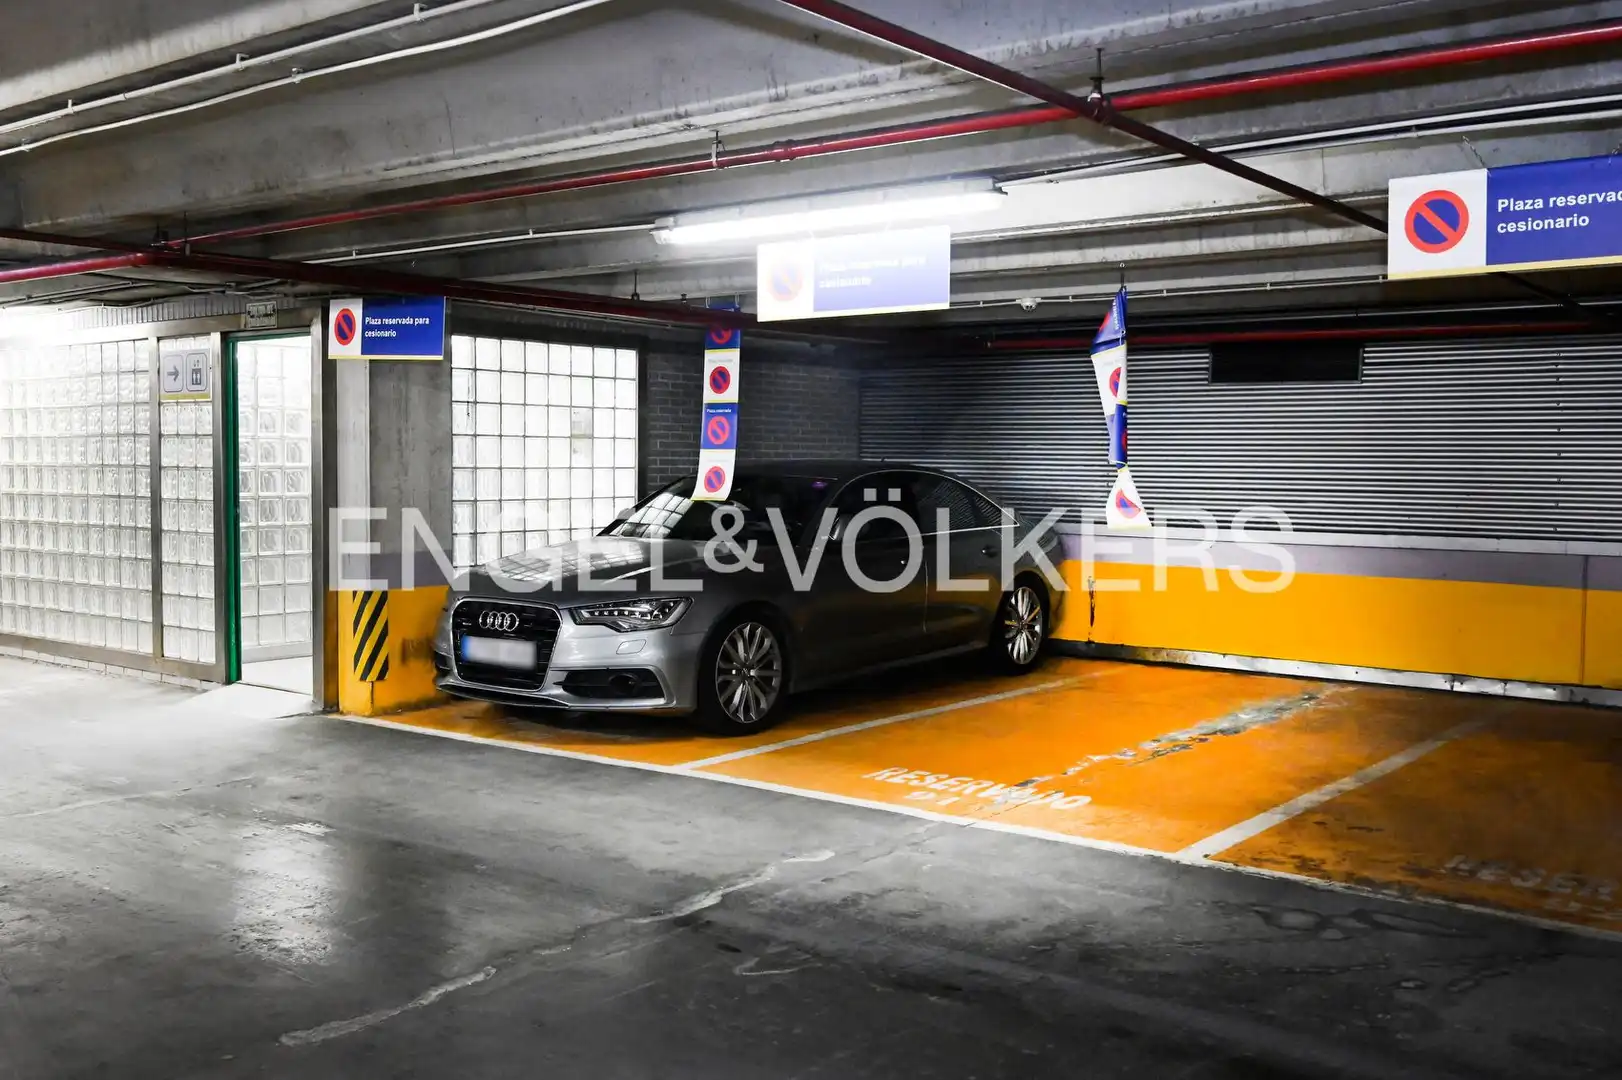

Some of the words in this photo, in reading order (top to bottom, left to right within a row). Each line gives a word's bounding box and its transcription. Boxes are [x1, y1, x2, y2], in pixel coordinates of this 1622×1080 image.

[1497, 197, 1543, 212] Plaza
[1497, 214, 1590, 233] cesionario
[365, 317, 381, 325] Plaza
[382, 316, 413, 325] reservada
[414, 317, 430, 326] para
[364, 329, 396, 337] cesionario
